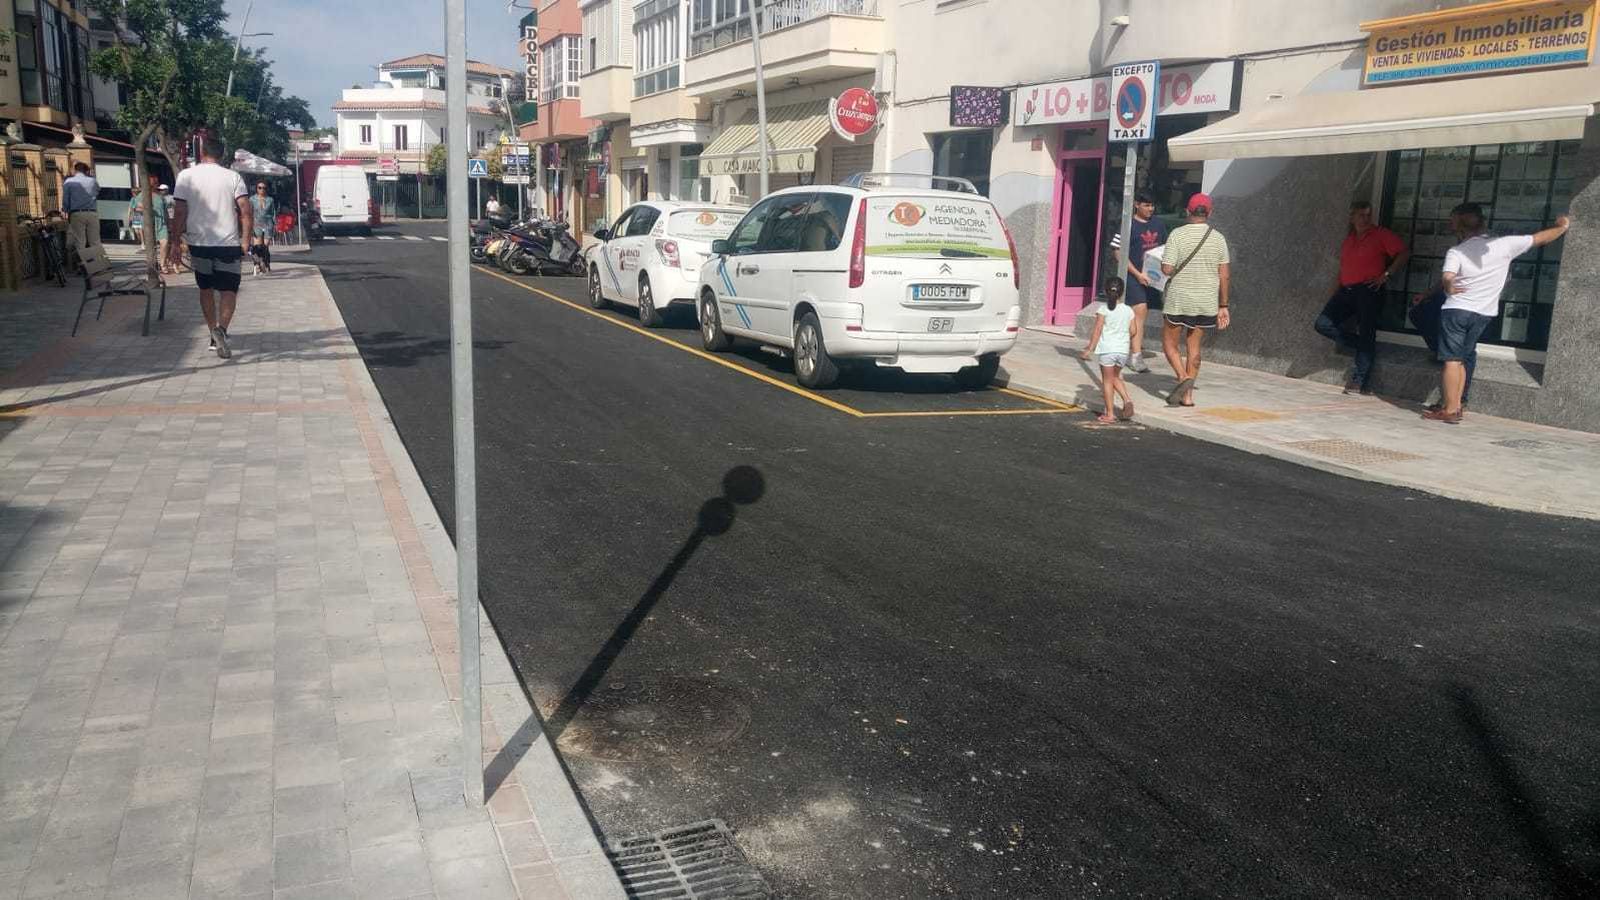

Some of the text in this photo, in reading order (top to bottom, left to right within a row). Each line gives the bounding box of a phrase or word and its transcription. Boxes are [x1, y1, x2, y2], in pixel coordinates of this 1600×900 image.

[1375, 11, 1584, 53] Gestión Inmobiliaria
[1372, 55, 1399, 68] VENTA
[1402, 53, 1414, 64] DE
[1416, 46, 1465, 62] VIVIENDAS
[1472, 39, 1519, 56] LOCALES
[1528, 31, 1588, 50] TERRENOS
[526, 28, 538, 101] DONCEL
[1114, 64, 1154, 77] EXCEPTO
[1044, 86, 1071, 117] LO
[1193, 94, 1217, 105] MODA
[1113, 129, 1144, 138] TAXI
[934, 204, 977, 216] AGENCIA
[929, 216, 987, 228] MEDIADORA
[920, 286, 947, 297] 0005
